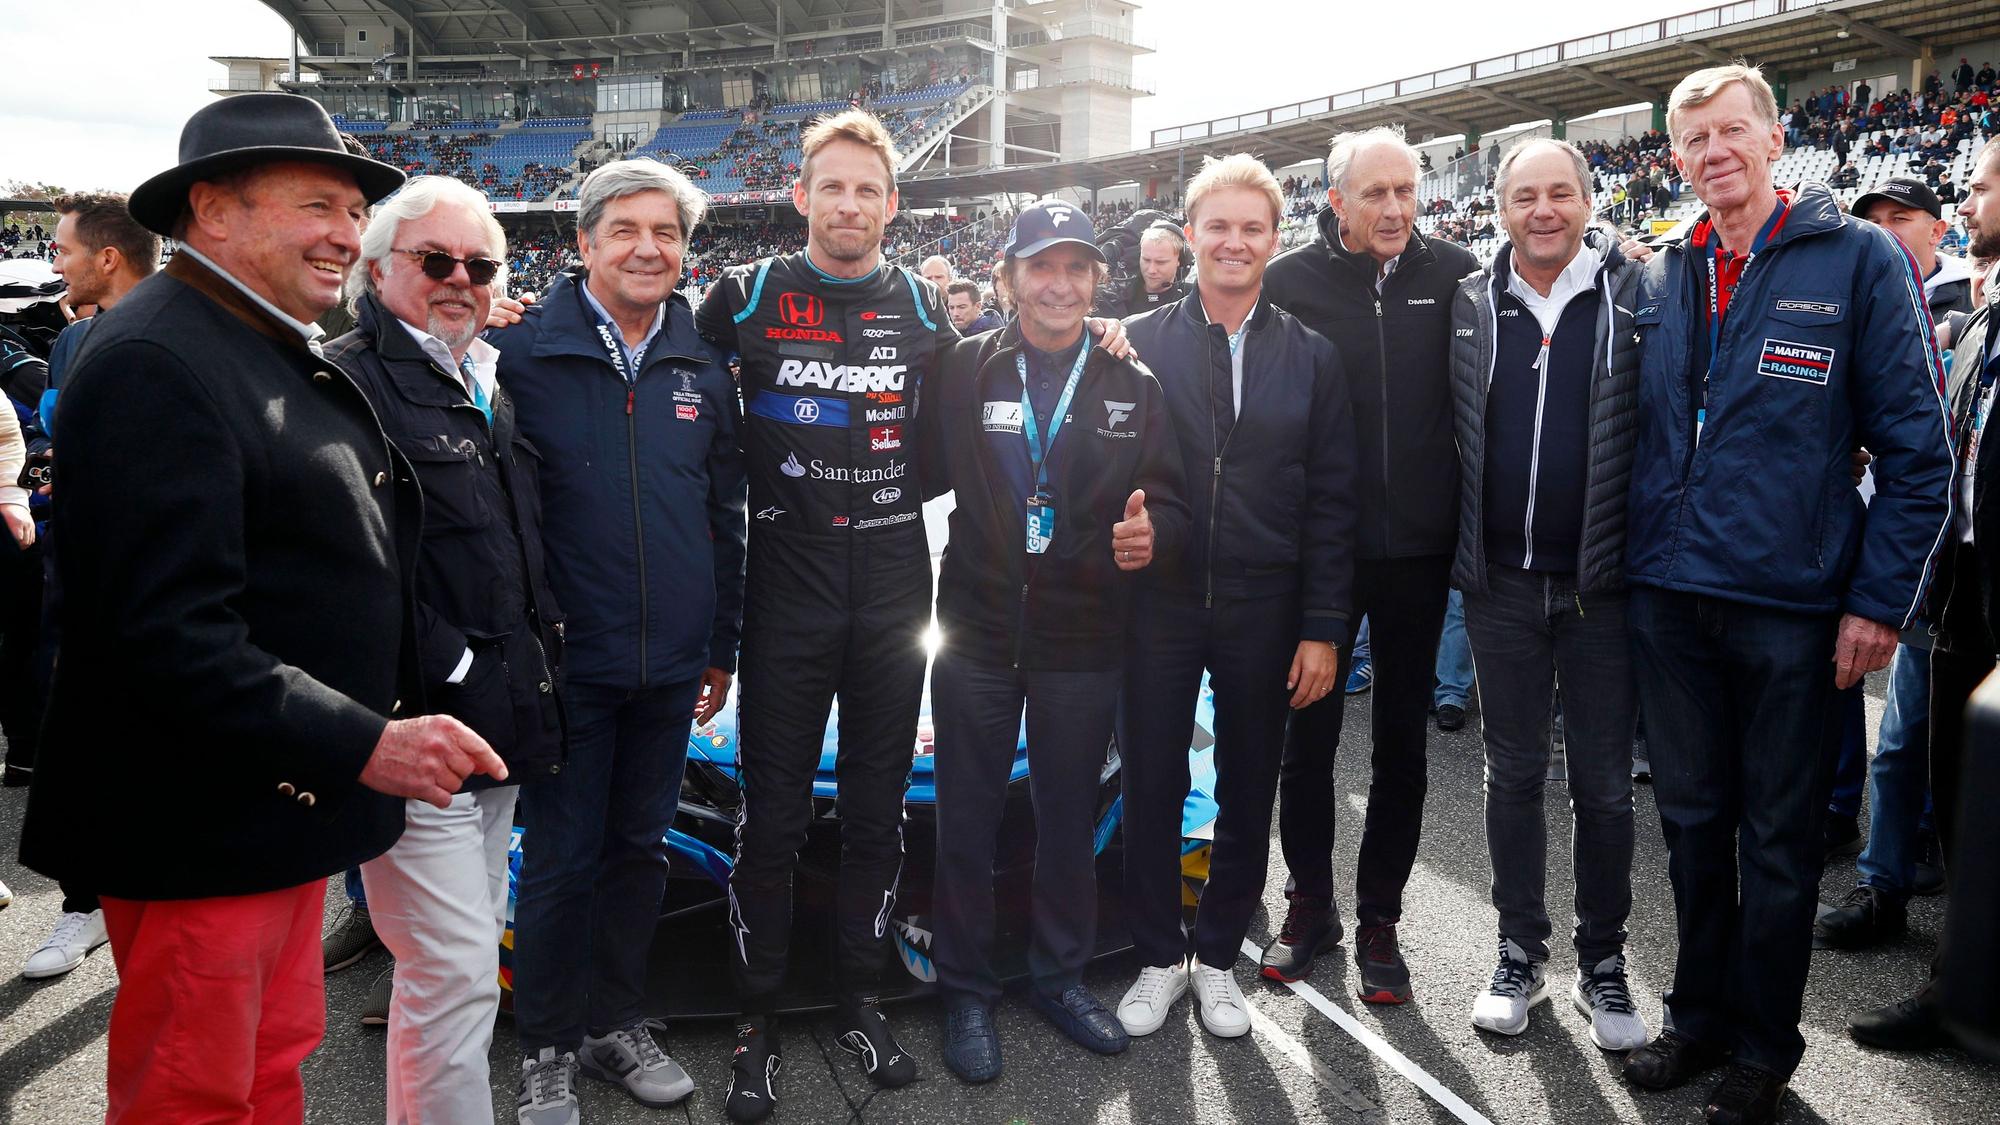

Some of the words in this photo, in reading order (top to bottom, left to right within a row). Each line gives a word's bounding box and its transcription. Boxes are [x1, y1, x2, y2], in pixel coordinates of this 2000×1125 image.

[1707, 257, 1717, 313] DTM.COM
[1779, 302, 1837, 312] PORSCHE
[765, 327, 845, 343] HONDA
[1456, 328, 1474, 337] DTM
[1774, 345, 1822, 361] MARTINI
[776, 359, 907, 393] RAYBRIG
[1770, 362, 1818, 377] RACING
[866, 408, 896, 422] Mobil
[810, 458, 906, 485] Santander
